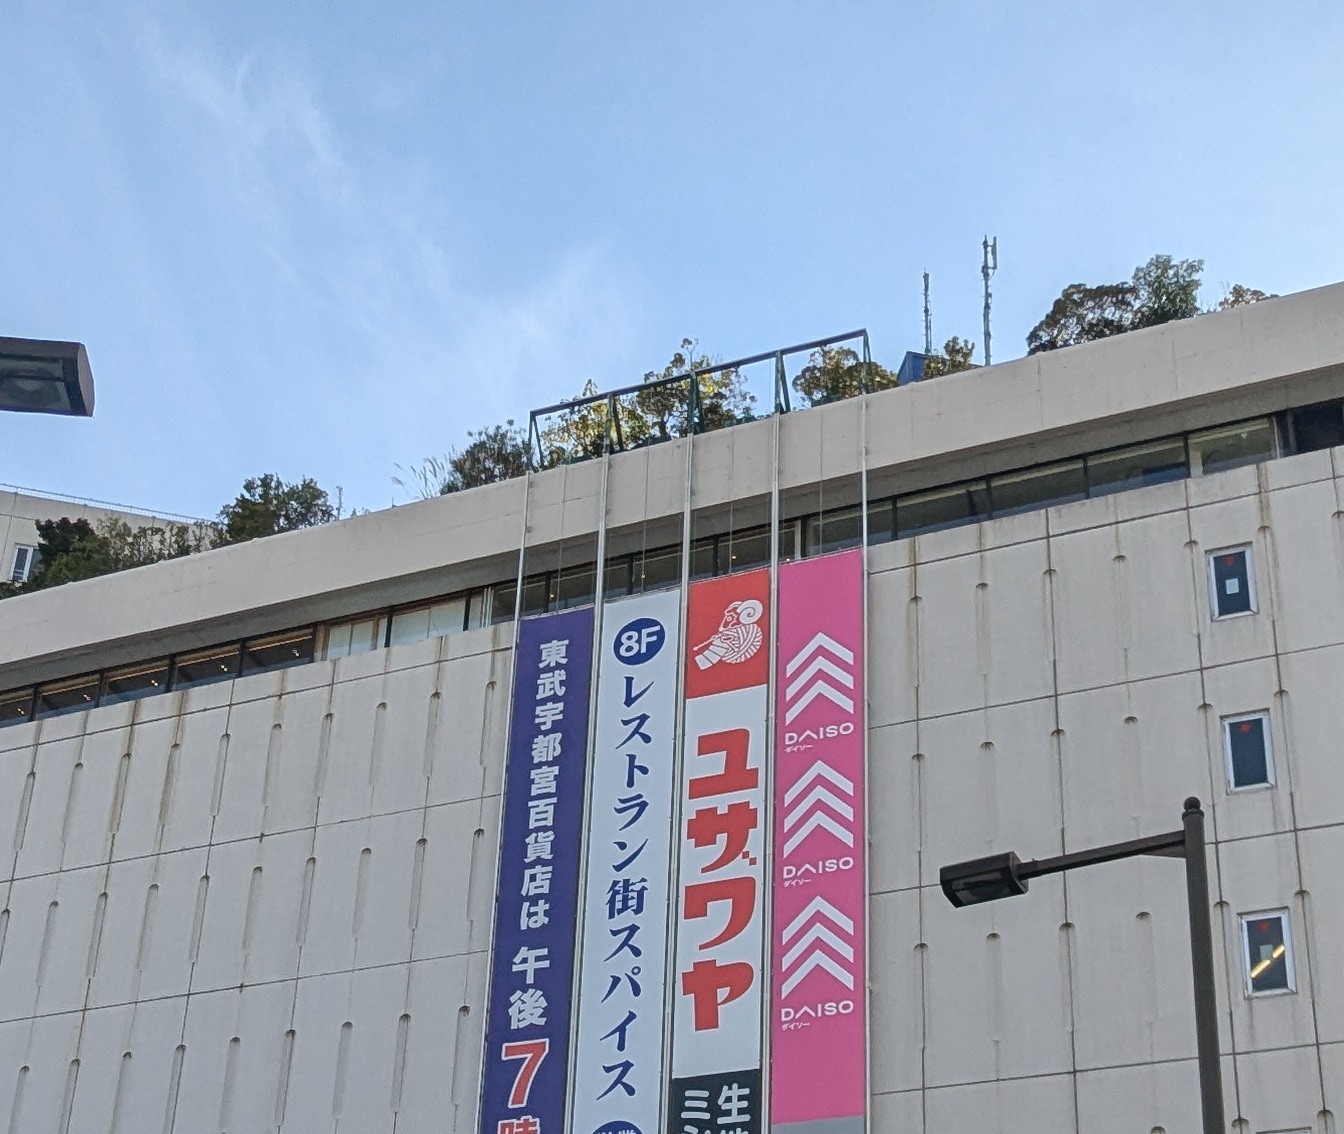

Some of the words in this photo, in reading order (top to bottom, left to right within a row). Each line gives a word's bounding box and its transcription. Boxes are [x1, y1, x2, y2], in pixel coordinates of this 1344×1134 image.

[619, 626, 661, 658] 8F
[785, 722, 854, 745] DAISO
[681, 728, 759, 1031] ユザワヤ
[783, 857, 854, 879] DAISO
[597, 675, 655, 1101] レストラン街スパイス
[780, 999, 854, 1022] DAISO
